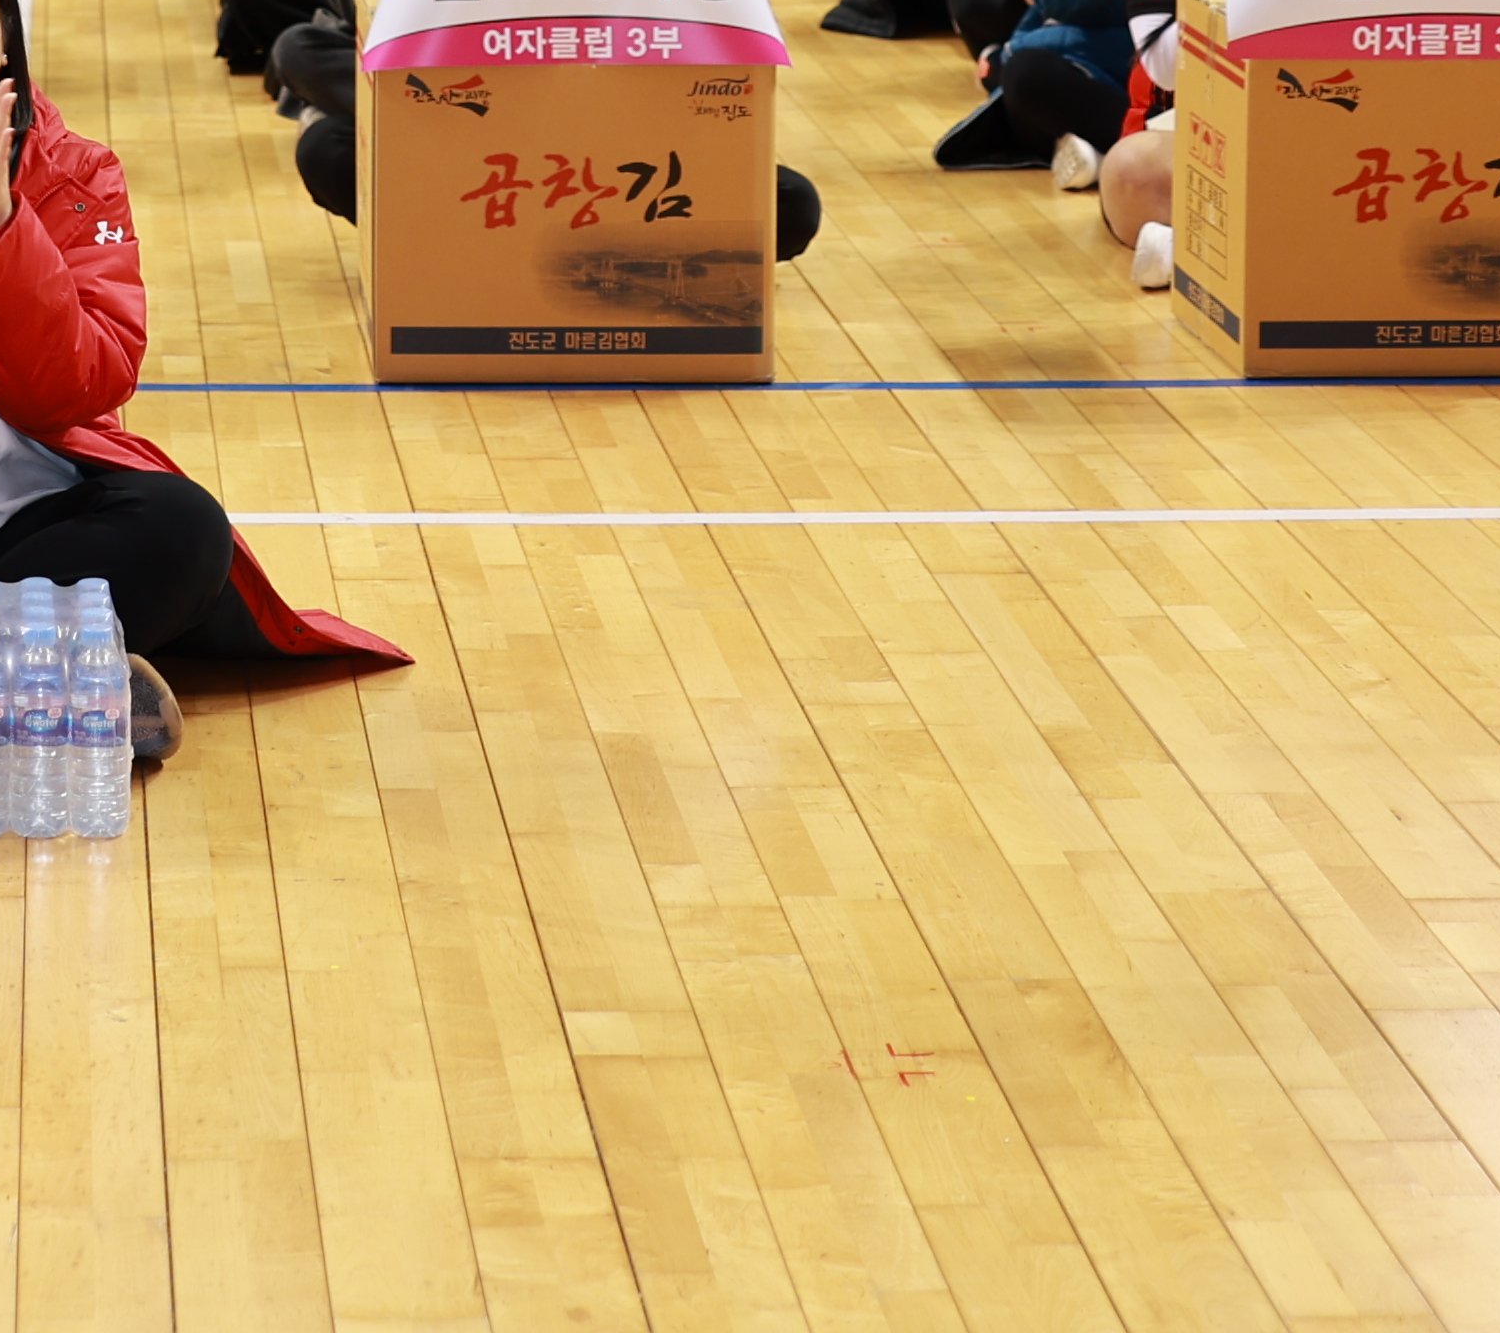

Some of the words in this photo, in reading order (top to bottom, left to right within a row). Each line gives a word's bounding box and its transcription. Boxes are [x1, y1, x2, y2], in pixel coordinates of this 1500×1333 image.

[482, 27, 614, 60] 여자클럽
[627, 28, 683, 59] 3부
[1352, 24, 1482, 56] 여자클럽
[687, 81, 743, 97] Jindo
[460, 150, 694, 229] 곱창김
[508, 331, 557, 351] 진도군
[565, 331, 647, 350] 마른김협회
[1375, 325, 1422, 343] 진도군
